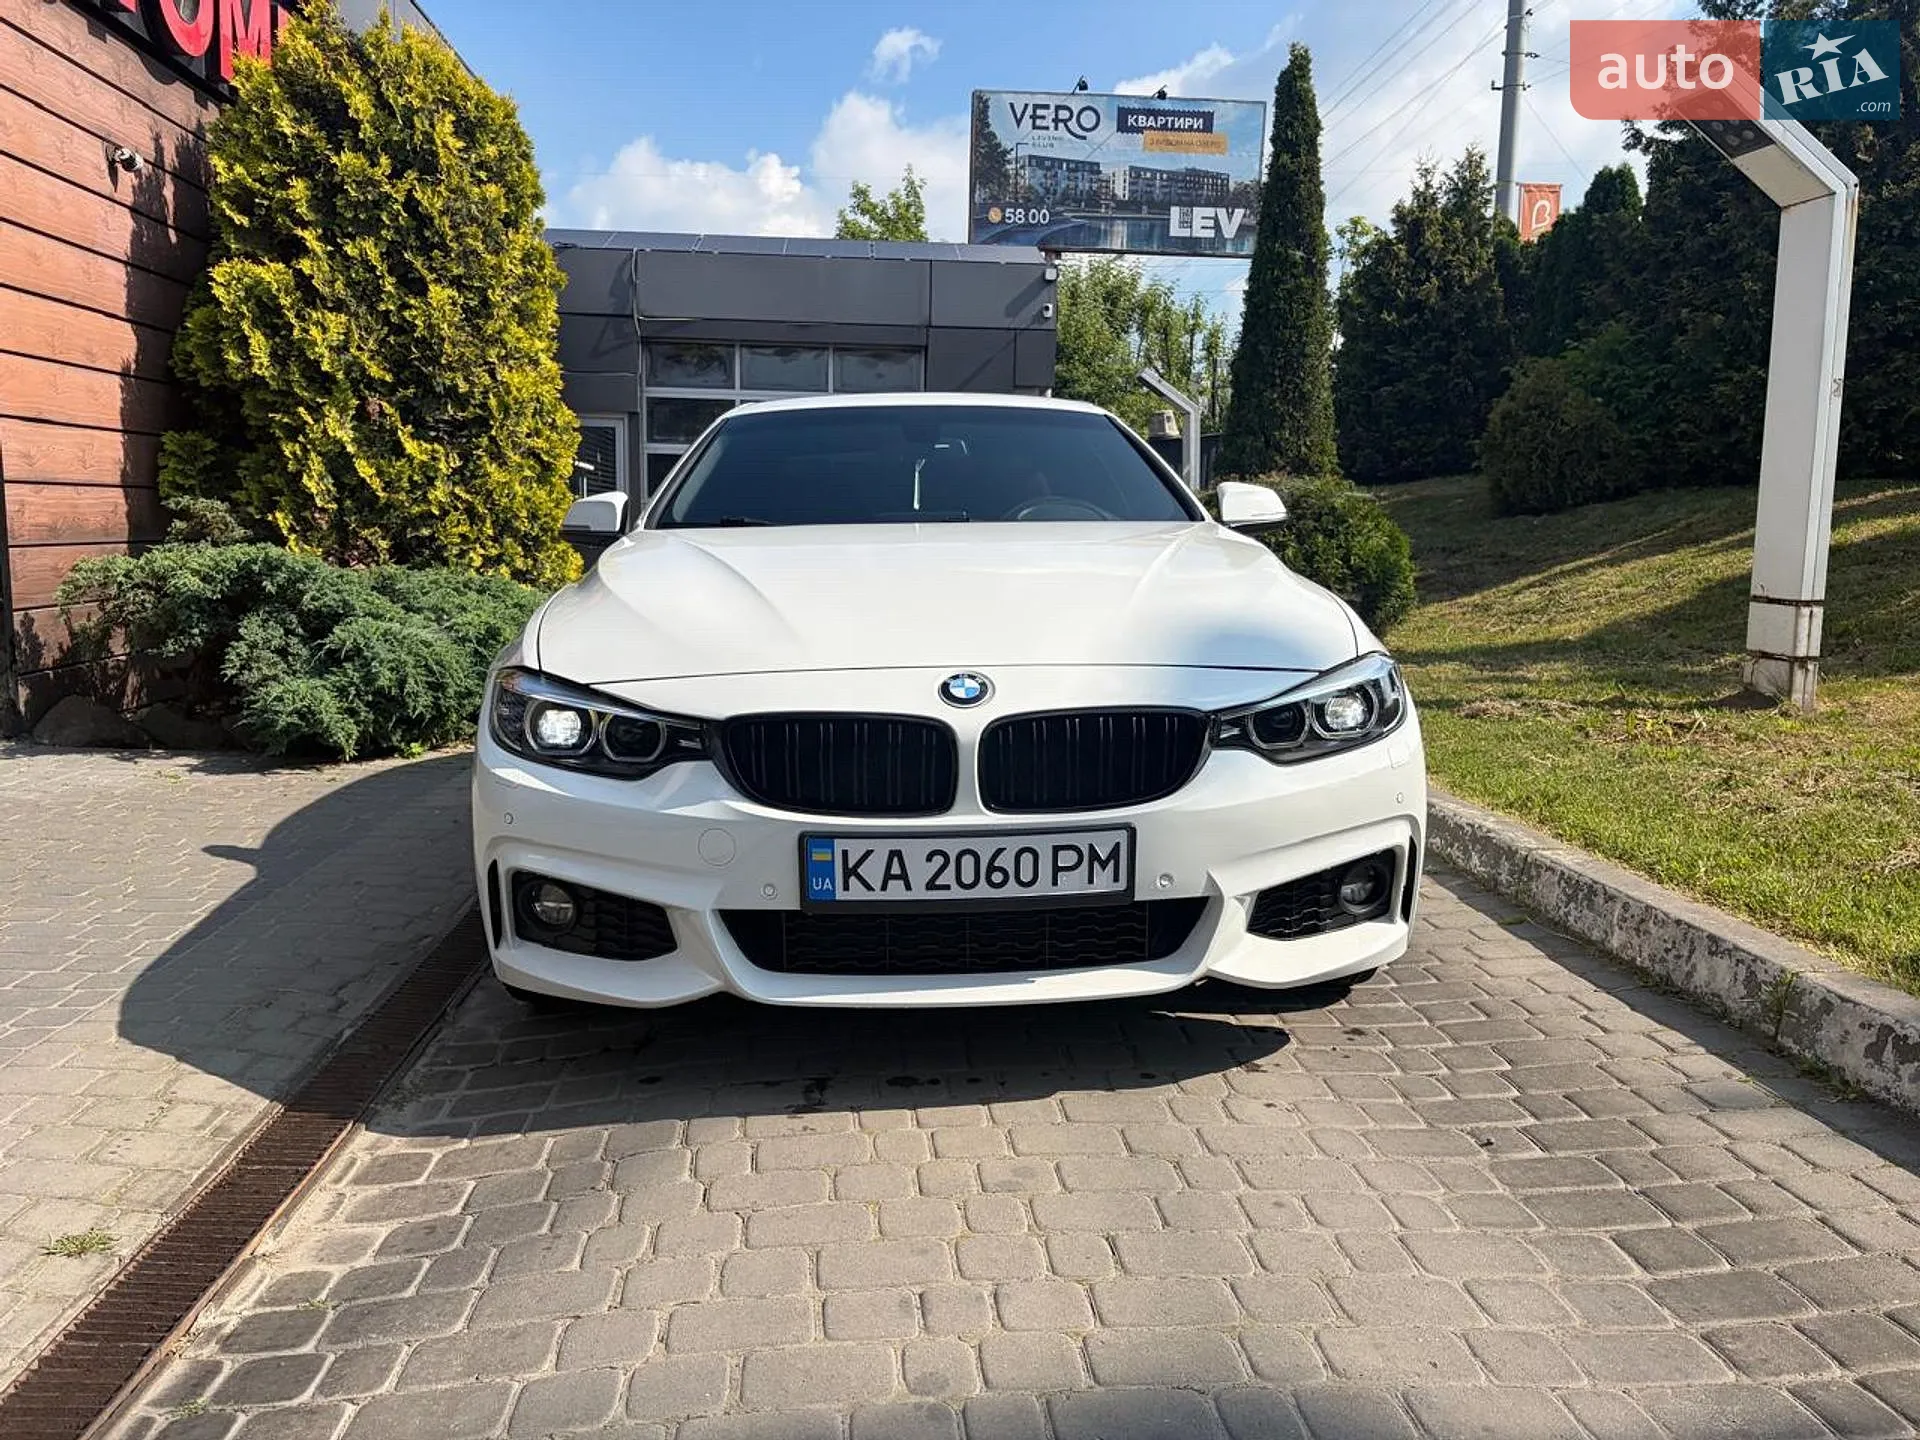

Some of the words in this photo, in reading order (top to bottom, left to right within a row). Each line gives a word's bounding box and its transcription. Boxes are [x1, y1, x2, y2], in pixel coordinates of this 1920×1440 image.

[1008, 102, 1101, 140] VERO
[1127, 114, 1203, 129] КВАРТИРИ
[1169, 205, 1246, 239] LEV
[841, 848, 913, 892] KA
[925, 846, 1040, 891] 2060
[1051, 841, 1121, 887] PM
[812, 877, 833, 891] UA
